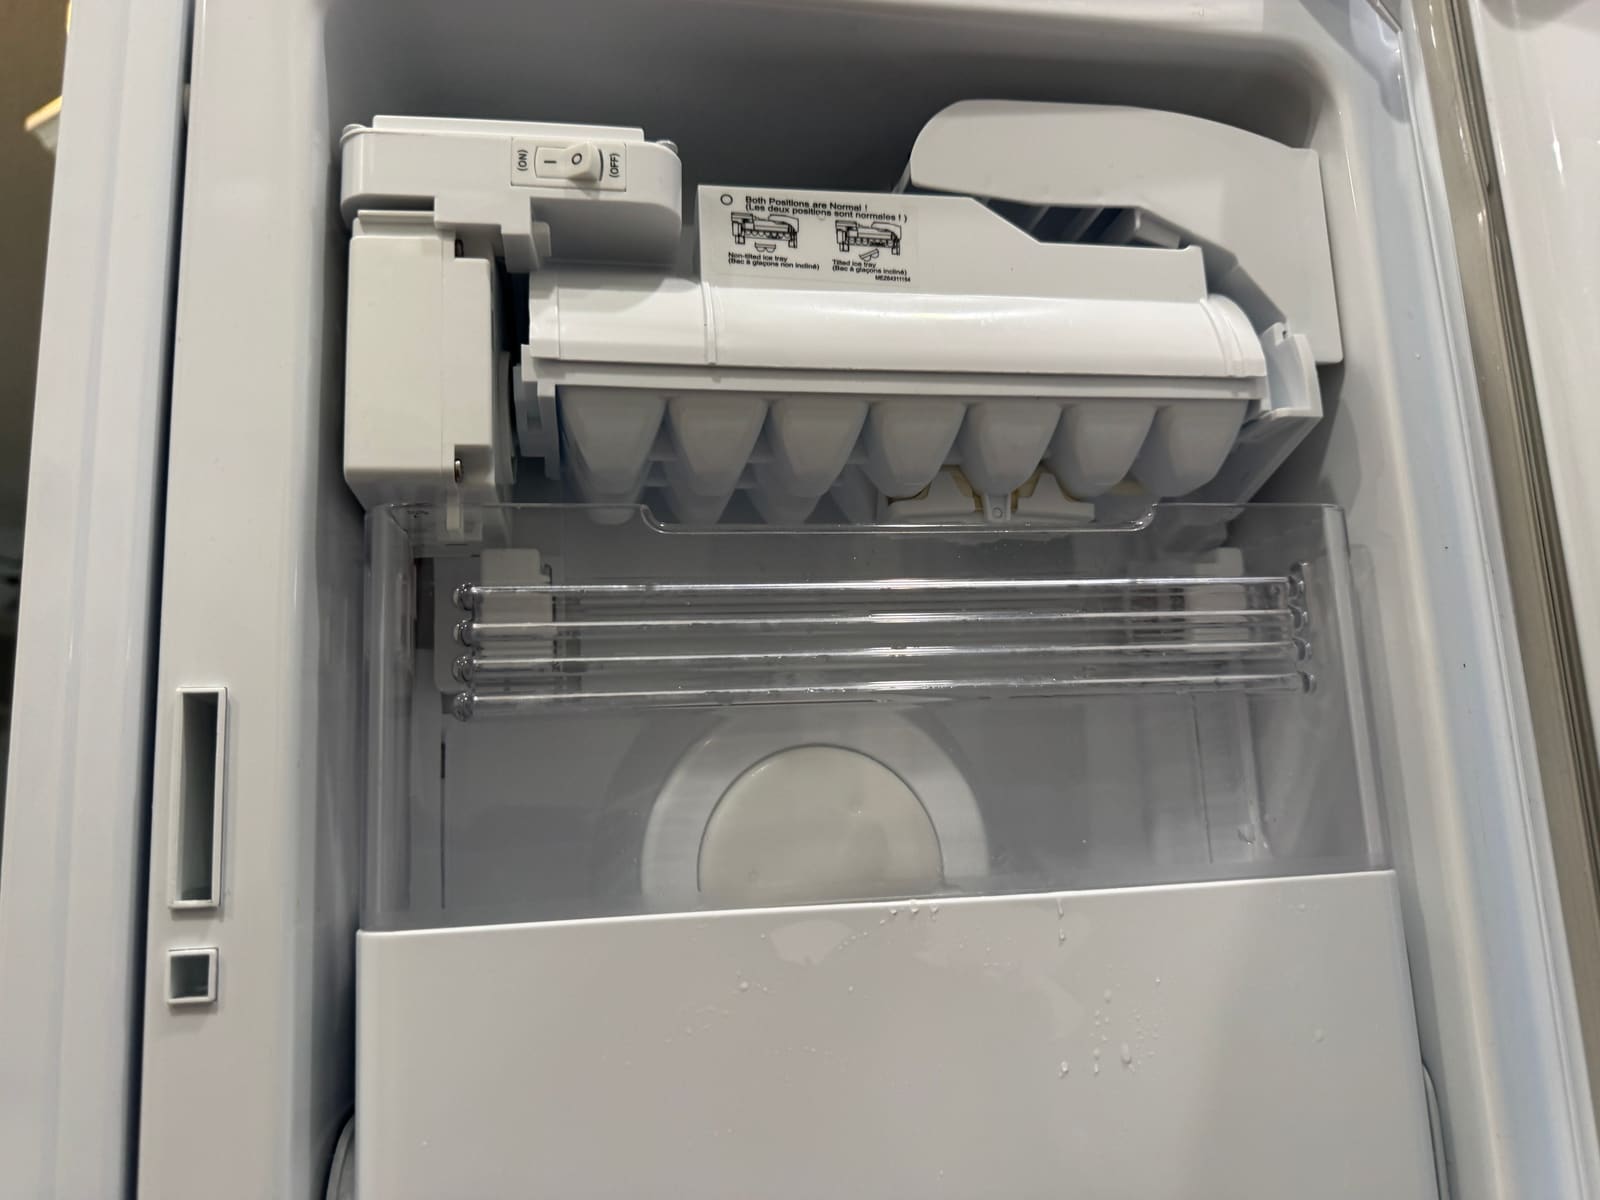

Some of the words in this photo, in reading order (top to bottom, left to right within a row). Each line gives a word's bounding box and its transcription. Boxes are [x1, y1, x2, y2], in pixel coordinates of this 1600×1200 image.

[517, 149, 528, 171] (ON)
[609, 153, 620, 178] (OFF)
[745, 195, 766, 205] Both
[769, 197, 809, 208] Positions
[812, 202, 827, 210] are
[829, 202, 861, 212] Normal
[745, 202, 765, 212] (Les
[768, 205, 790, 214] deux
[792, 206, 832, 217] positions
[834, 210, 853, 218] sont
[855, 212, 896, 221] normales
[728, 251, 761, 260] Non-tilted
[774, 255, 788, 263] tray
